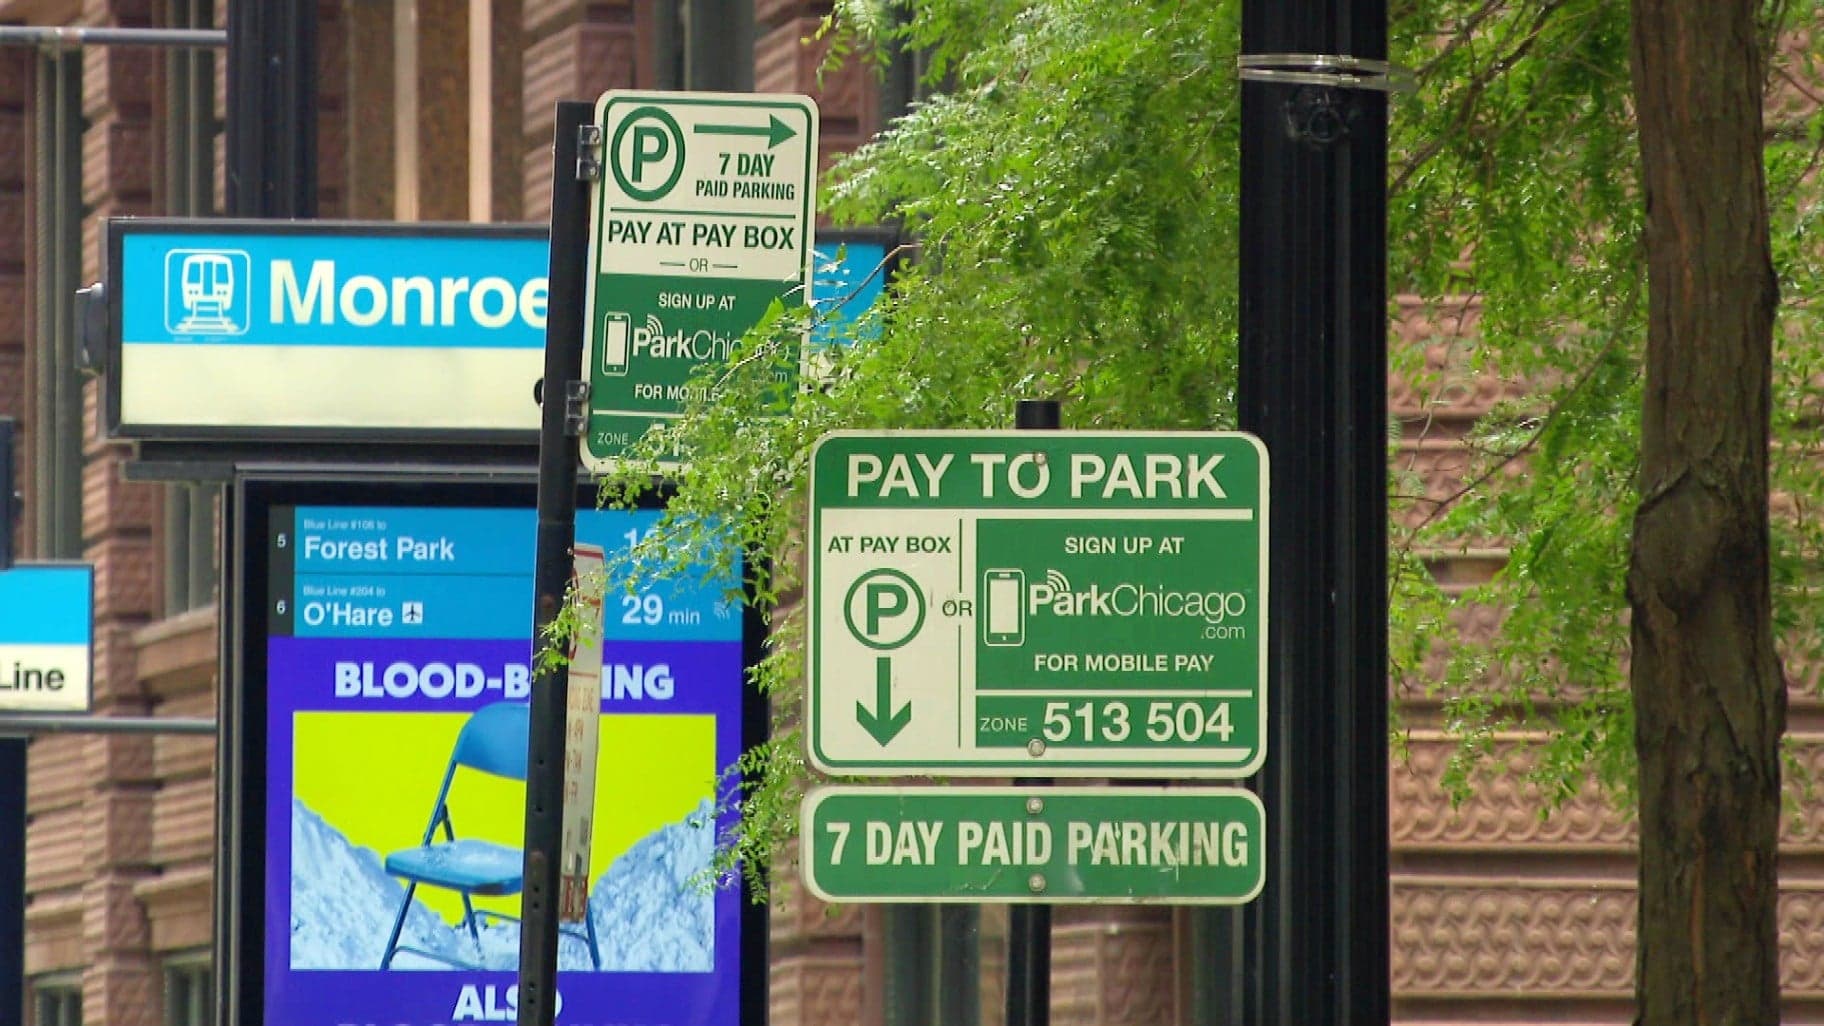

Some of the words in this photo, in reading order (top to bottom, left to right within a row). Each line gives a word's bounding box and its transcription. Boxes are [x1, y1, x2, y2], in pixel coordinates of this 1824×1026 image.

[718, 152, 731, 176] 7
[737, 153, 775, 178] DAY
[695, 179, 728, 199] PAID
[733, 181, 795, 201] PARKING
[608, 220, 652, 244] PAY
[656, 222, 685, 246] AT
[693, 224, 736, 248] PAY
[744, 226, 795, 250] BOX
[689, 258, 709, 273] OR
[269, 259, 549, 331] Monroe
[658, 292, 692, 309] SIGN
[695, 294, 716, 310] UP
[717, 295, 736, 312] AT
[634, 383, 663, 400] FOR
[597, 433, 629, 446] ZONE
[847, 453, 955, 498] PAY
[971, 453, 1050, 499] TO
[1070, 453, 1228, 499] PARK
[276, 533, 287, 549] 5
[303, 535, 388, 560] Forest
[396, 535, 454, 561] Park
[828, 536, 857, 554] AT
[860, 536, 900, 554] PAY
[906, 536, 952, 555] BOX
[1064, 536, 1119, 555] SIGN
[1123, 537, 1152, 555] UP
[1156, 537, 1185, 555] AT
[276, 600, 286, 615] 6
[303, 601, 393, 626] O'Hare
[621, 593, 664, 626] 29
[668, 608, 701, 625] min
[942, 600, 973, 617] OR
[1028, 583, 1247, 624] ParkChicago
[1034, 654, 1079, 672] FOR
[1085, 655, 1168, 672] MOBILE
[1175, 655, 1215, 672] PAY
[980, 716, 1028, 733] ZONE
[1042, 701, 1132, 743] 513
[1146, 701, 1234, 743] 504
[825, 821, 852, 866] 7
[865, 821, 943, 866] DAY
[958, 821, 1052, 866] PAID
[1067, 820, 1249, 867] PARKING
